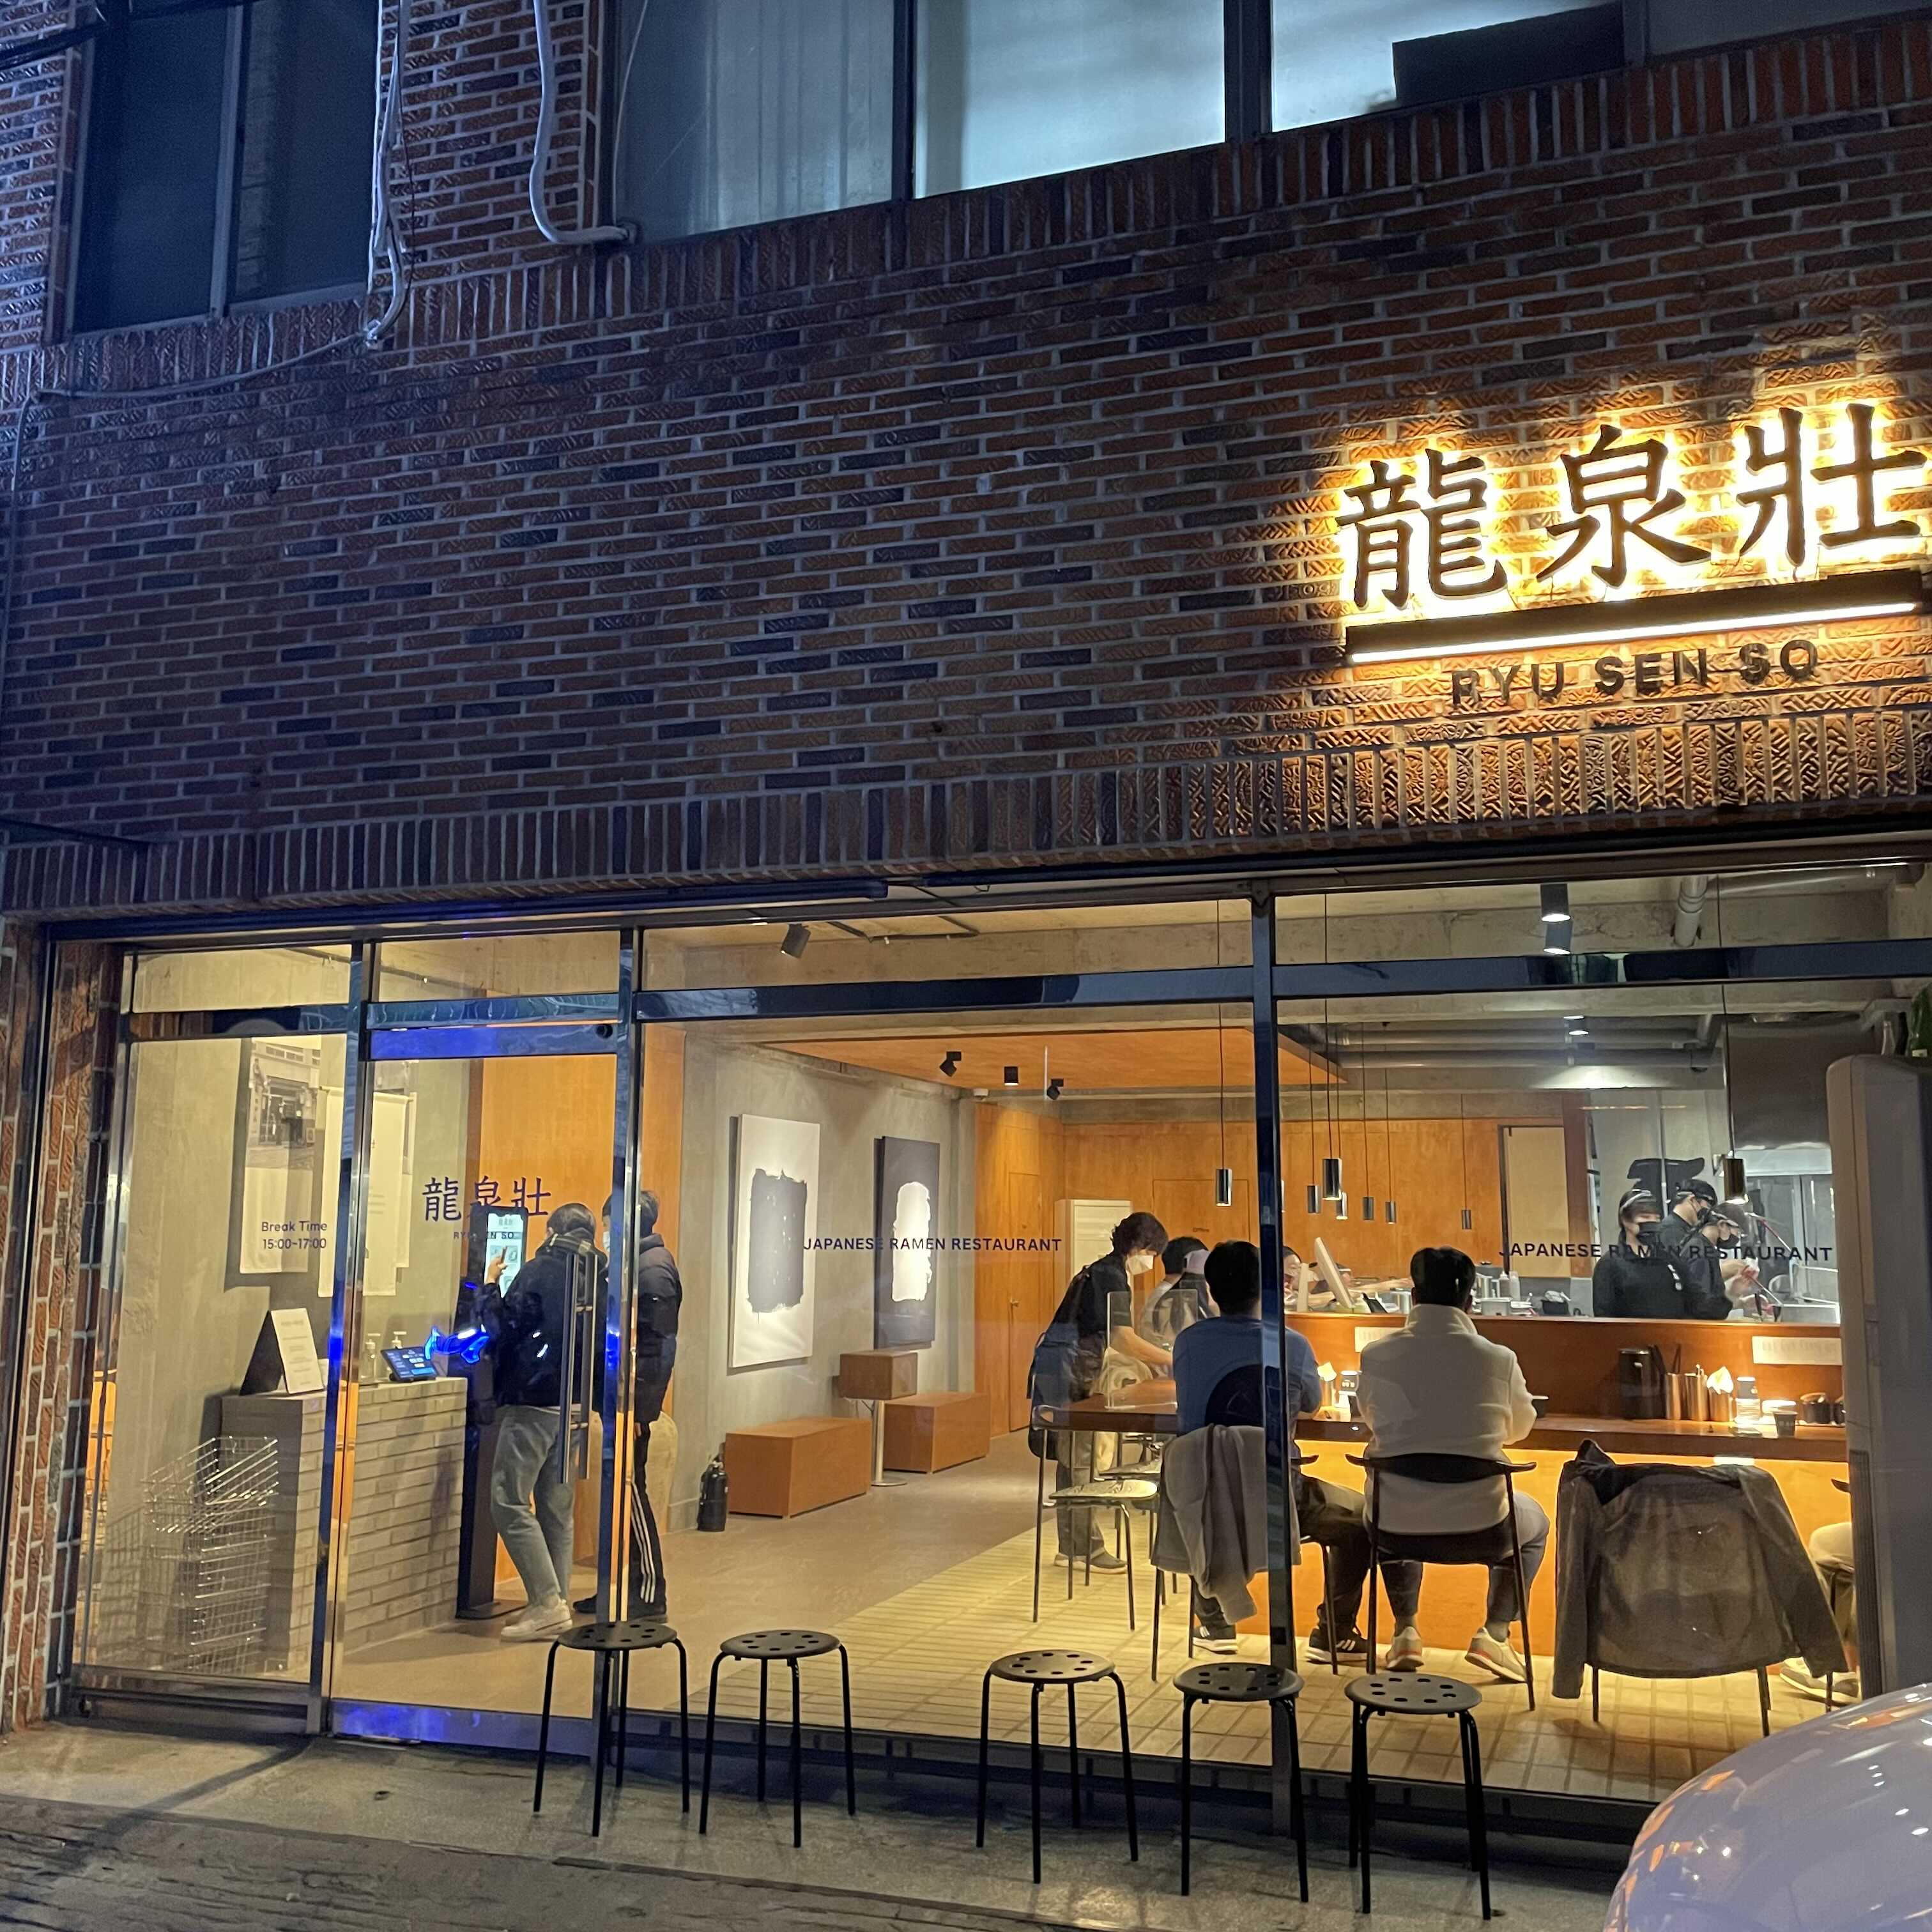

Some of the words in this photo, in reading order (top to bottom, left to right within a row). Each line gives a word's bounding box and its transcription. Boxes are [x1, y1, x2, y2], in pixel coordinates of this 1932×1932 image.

[1334, 402, 1928, 611] 龍泉壯
[1452, 662, 1564, 706] RYU
[1595, 648, 1709, 696] SEN
[1739, 640, 1819, 686] SO
[261, 1221, 296, 1232] Break
[298, 1220, 328, 1232] Time
[501, 1231, 514, 1239] SO
[803, 1238, 884, 1250] JAPANESE
[889, 1238, 946, 1250] RAMEN
[951, 1238, 1062, 1251] RESTAURANT
[1609, 1244, 1681, 1258] RAMN
[1690, 1245, 1832, 1261] RESTAURANT
